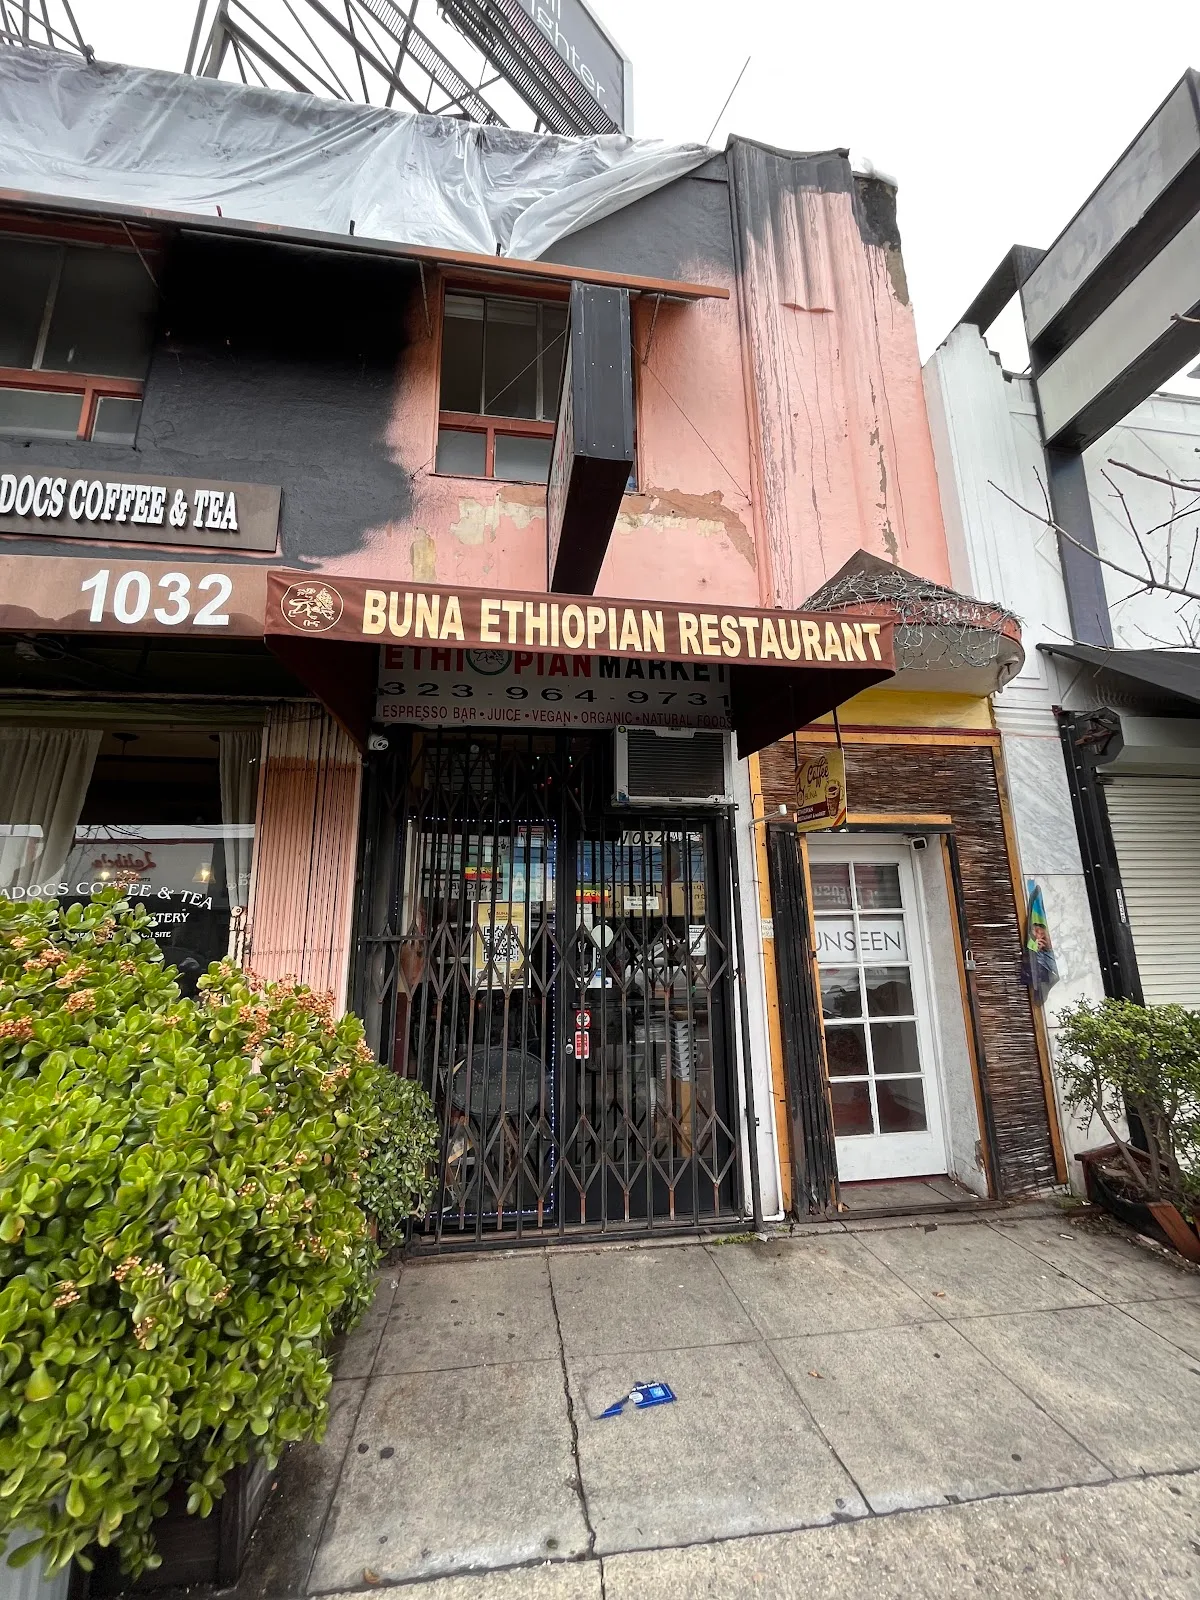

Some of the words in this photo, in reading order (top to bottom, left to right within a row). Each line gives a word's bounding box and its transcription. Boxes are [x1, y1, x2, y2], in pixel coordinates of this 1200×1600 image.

[69, 479, 167, 525] COFFEE
[169, 488, 188, 527] &
[193, 489, 239, 531] TEA
[81, 569, 233, 626] 1032
[362, 589, 465, 641] BUNA
[480, 598, 666, 653] ETHIOPIAN
[678, 611, 882, 662] RESTAURANT
[383, 704, 448, 720] ESPRESSO
[453, 707, 476, 720] BAR
[487, 708, 521, 722] JUICE
[532, 709, 571, 723] VEGAN
[581, 711, 633, 724] ORGANIC
[642, 712, 692, 726] NATURAL
[697, 714, 732, 728] FOODS
[807, 756, 829, 788] Coffee
[157, 886, 175, 901] &
[180, 889, 213, 911] TEA
[154, 930, 172, 939] SITE
